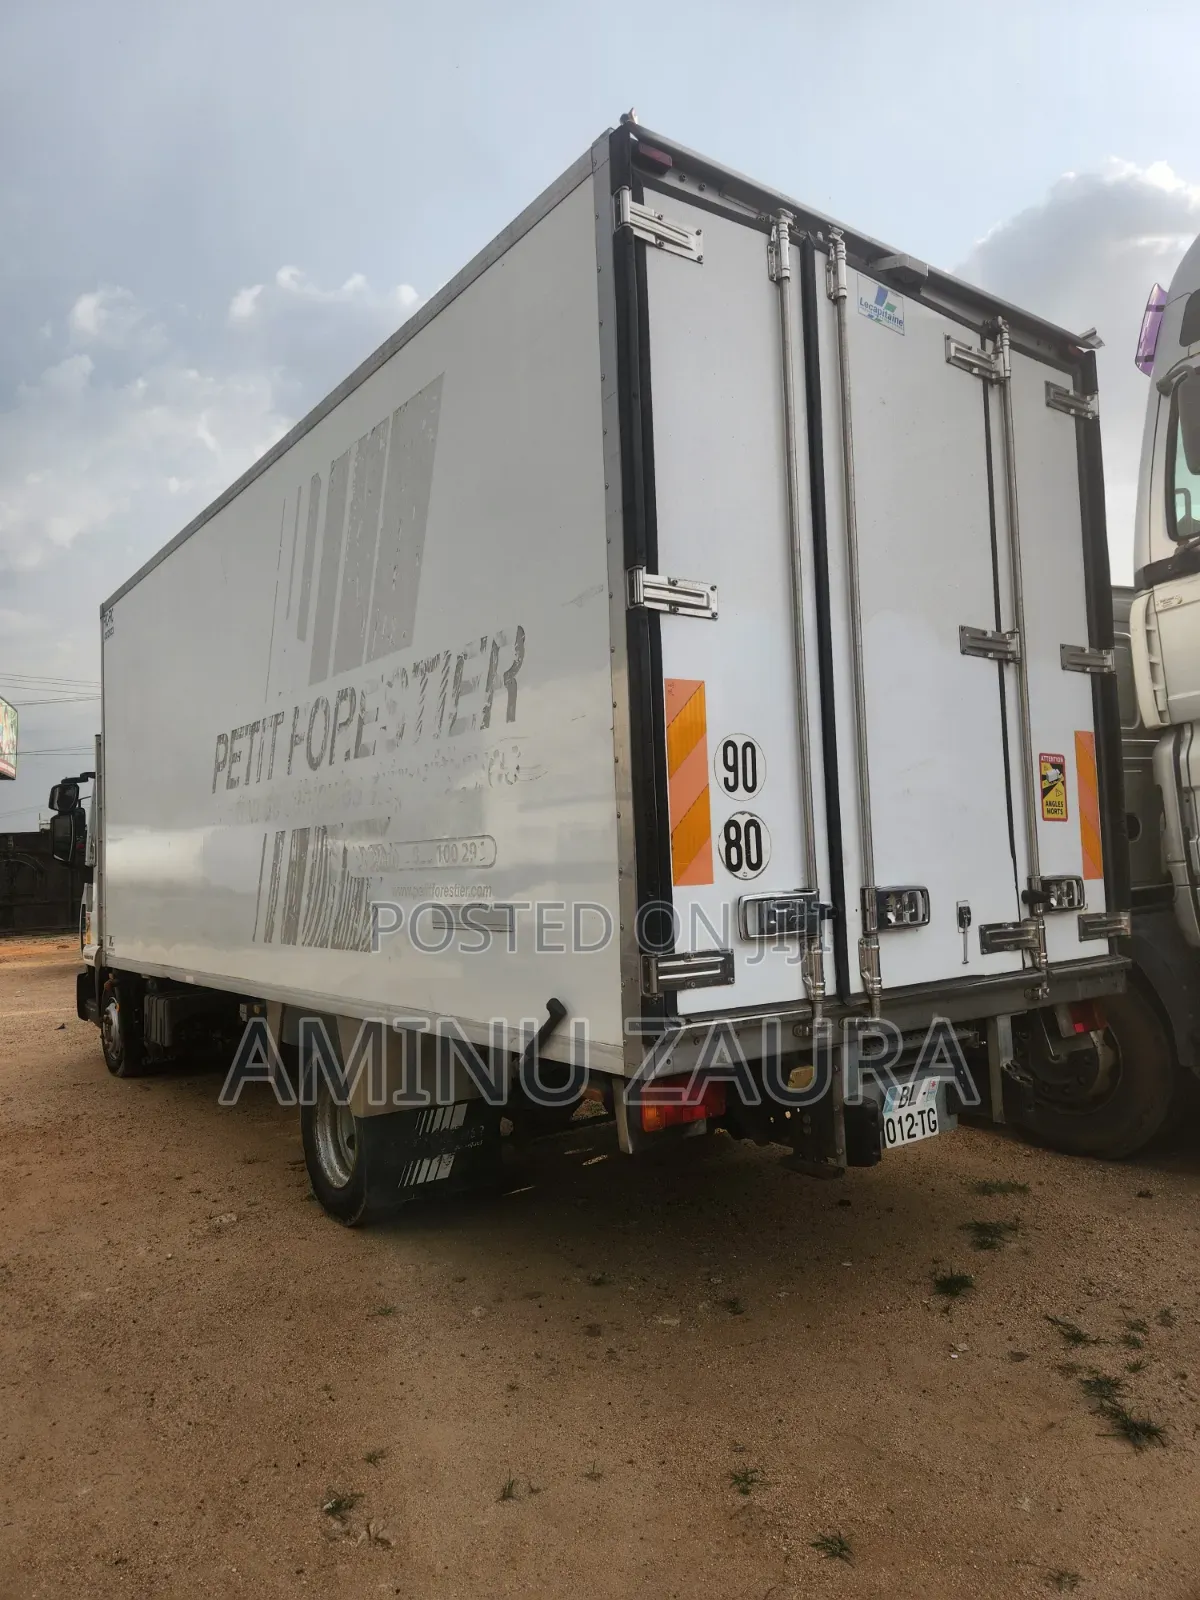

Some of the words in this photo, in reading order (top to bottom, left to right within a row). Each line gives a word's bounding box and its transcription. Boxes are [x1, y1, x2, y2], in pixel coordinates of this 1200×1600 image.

[212, 711, 285, 794] PETIT
[722, 739, 757, 793] 90
[1041, 755, 1064, 763] ATTENTION
[1045, 800, 1064, 808] ANGLES
[723, 818, 763, 872] 80
[885, 1107, 937, 1144] 012-TG
